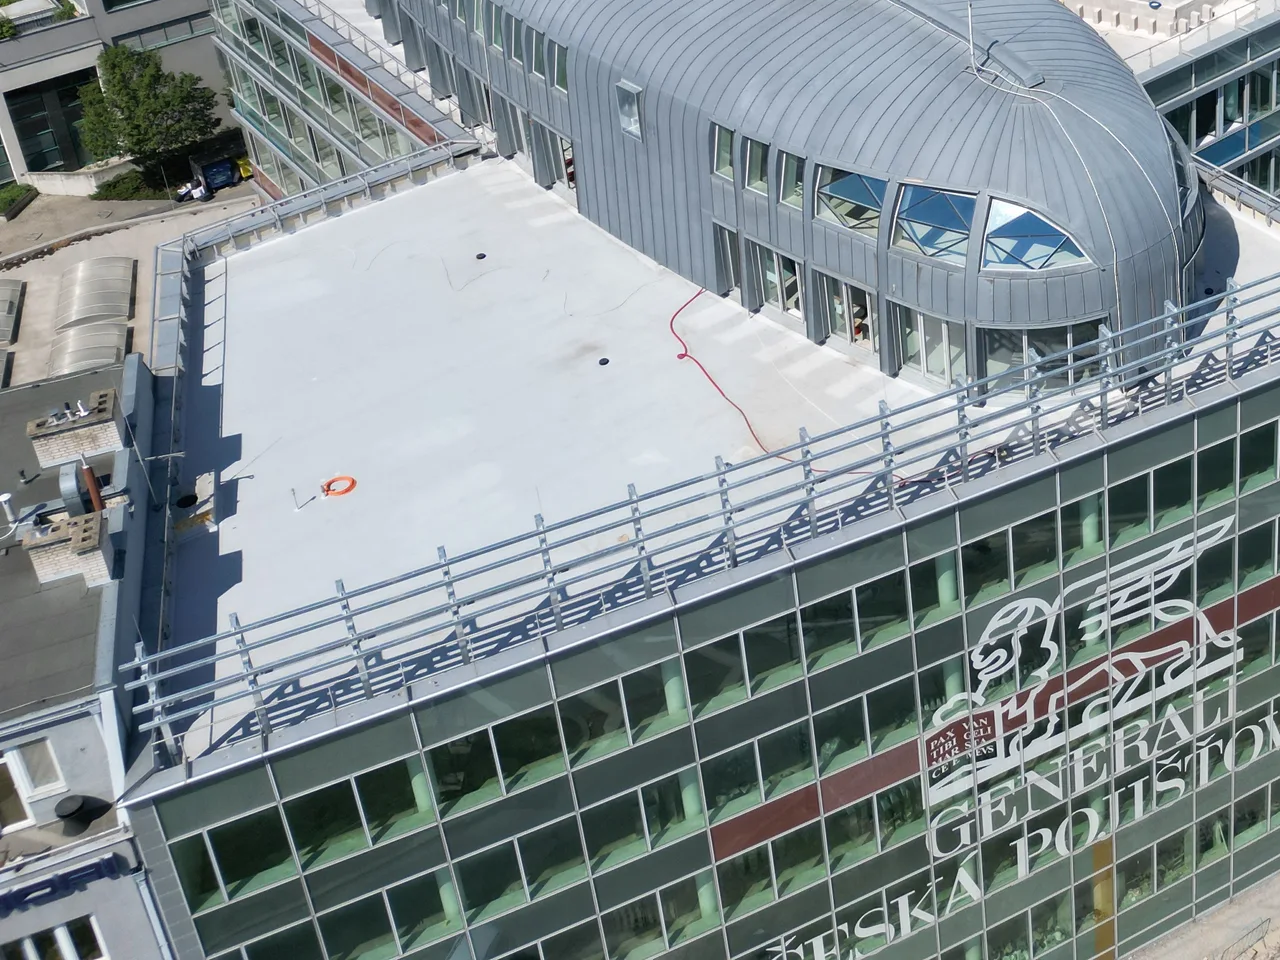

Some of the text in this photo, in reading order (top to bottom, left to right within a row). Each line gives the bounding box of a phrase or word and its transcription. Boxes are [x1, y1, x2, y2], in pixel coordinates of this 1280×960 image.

[962, 717, 988, 730] VAN
[963, 726, 992, 739] GELI
[930, 728, 956, 750] PAX
[930, 737, 958, 759] TIBI
[964, 738, 987, 750] STA
[926, 670, 1243, 859] GENERALI
[930, 746, 960, 766] MAR
[932, 762, 949, 779] CE
